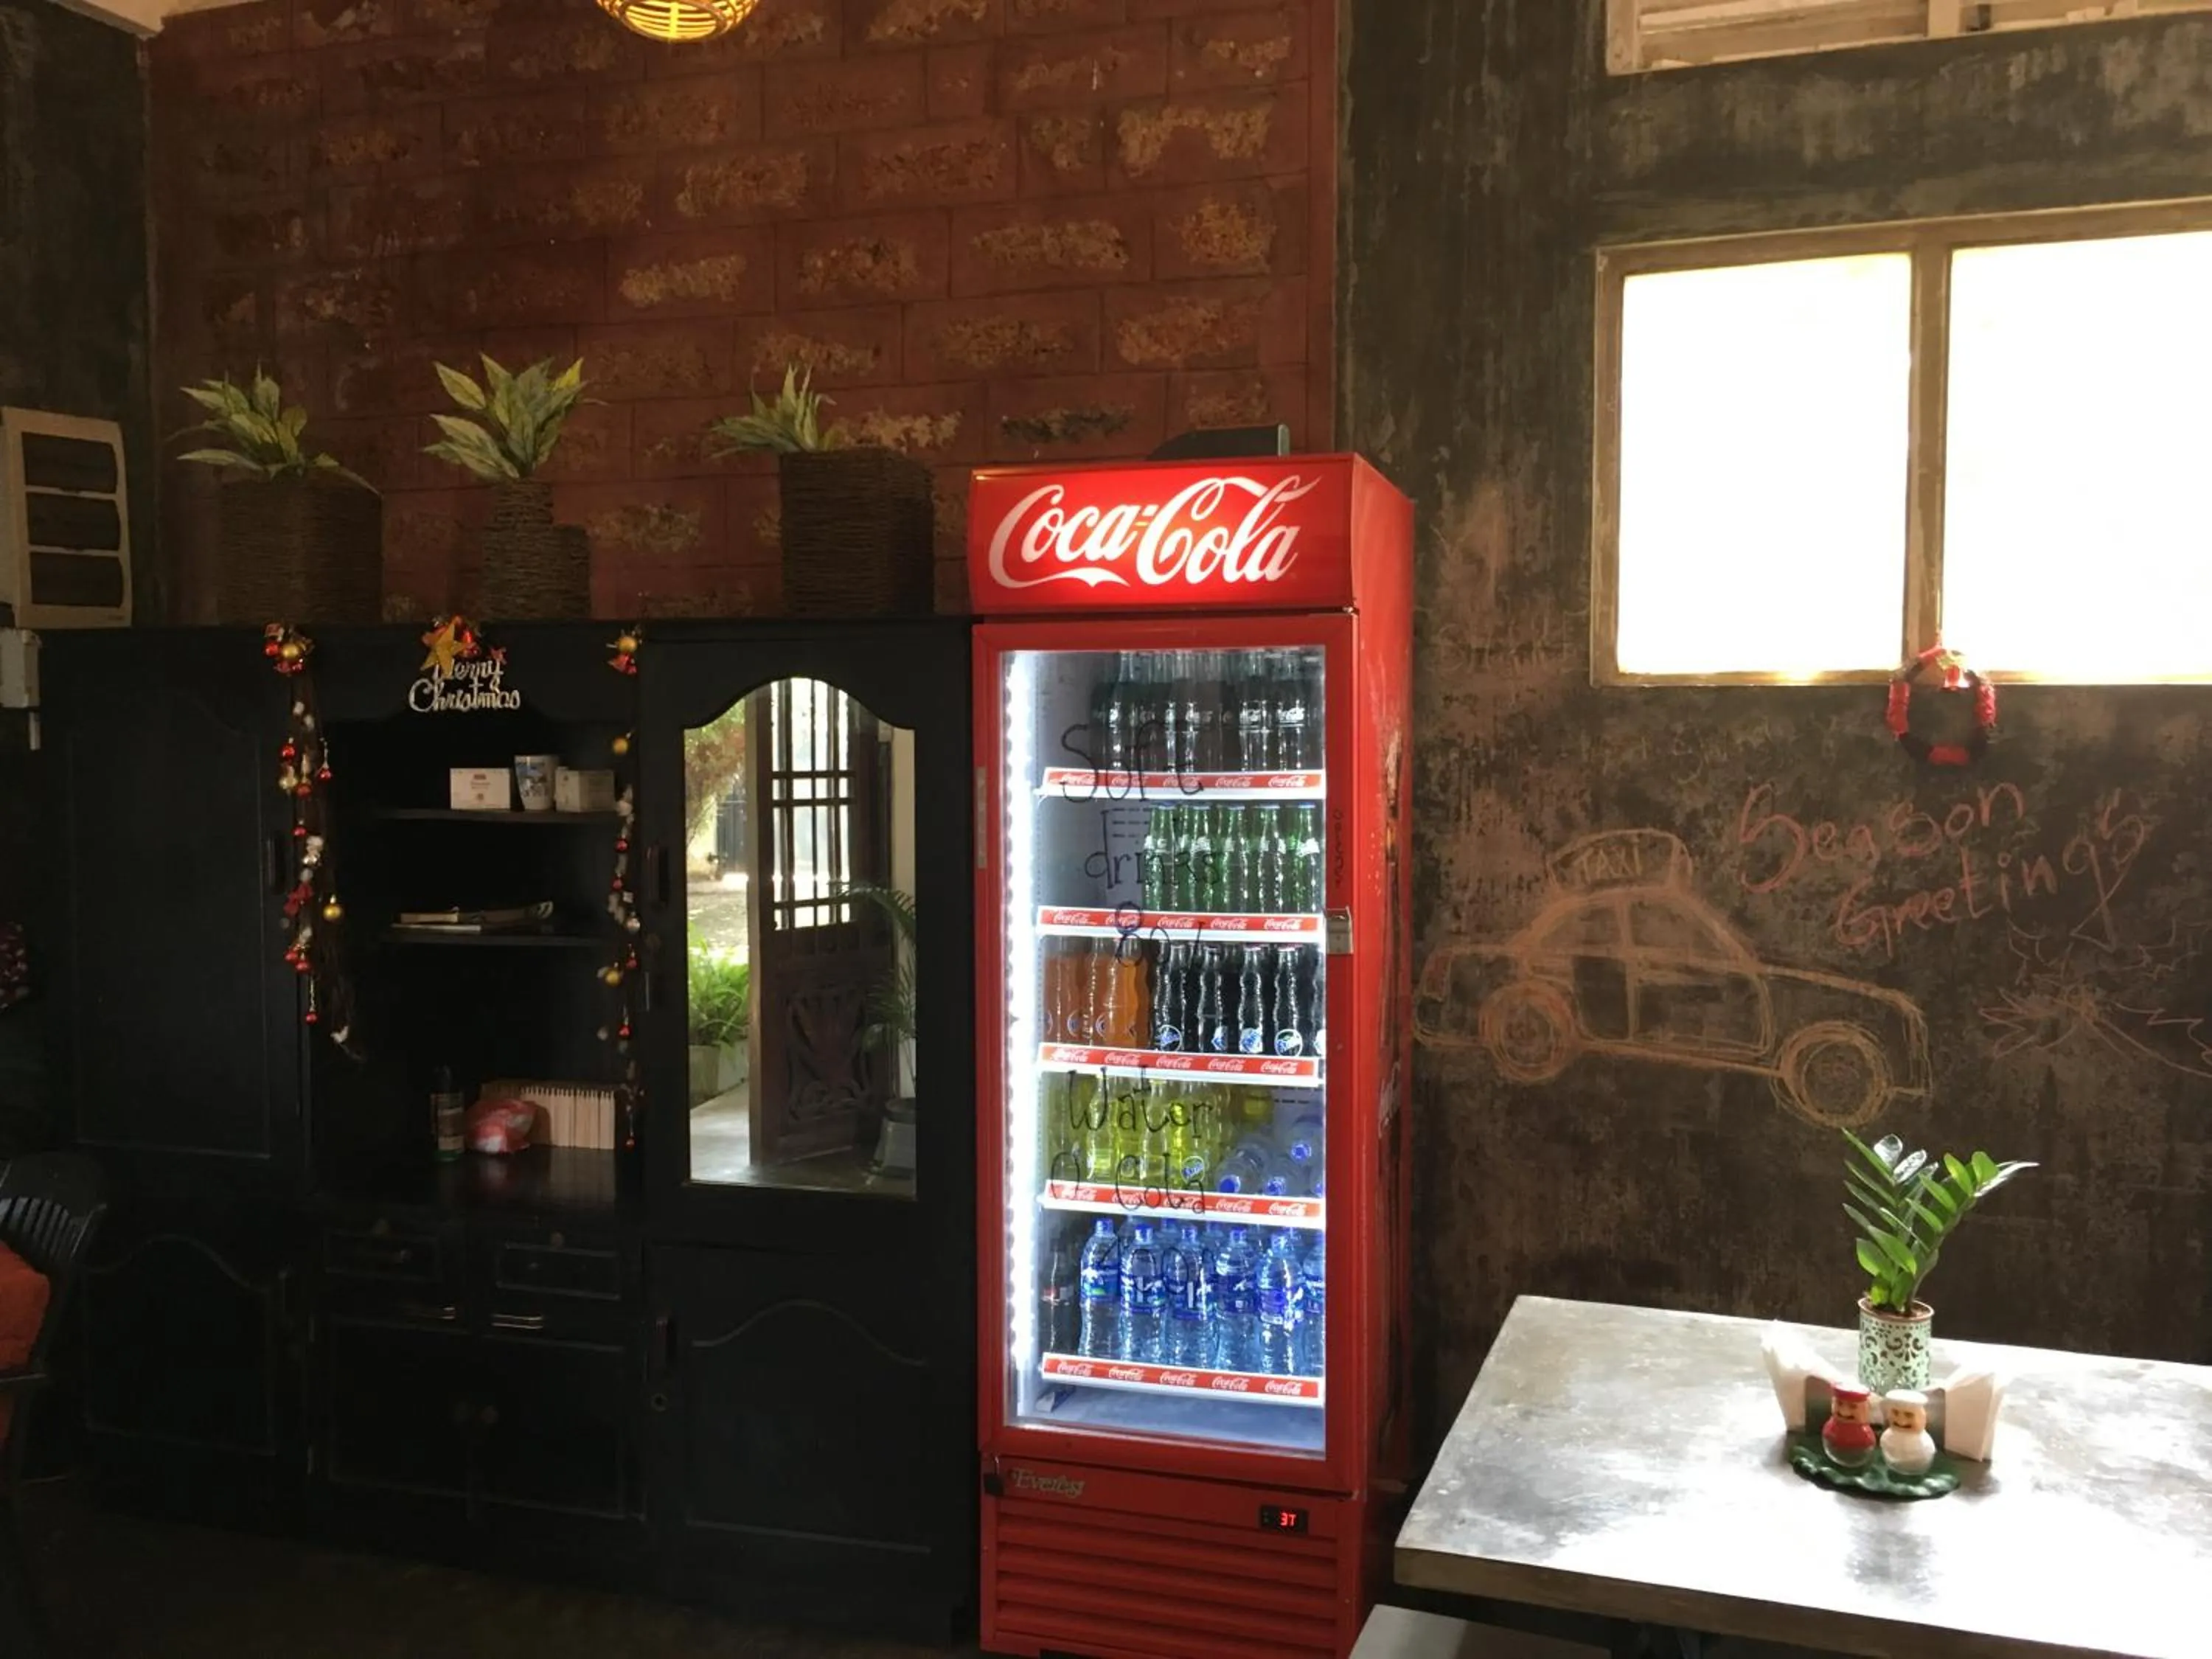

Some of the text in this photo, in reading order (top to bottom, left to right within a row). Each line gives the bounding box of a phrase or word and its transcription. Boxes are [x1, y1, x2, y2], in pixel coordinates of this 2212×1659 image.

[988, 474, 1323, 588] Coca-Cola
[409, 678, 521, 712] Christmas
[1060, 717, 1204, 803] Soft
[1739, 783, 2026, 893] Season
[1834, 787, 2147, 958] Greetings
[1068, 1065, 1214, 1138] Water
